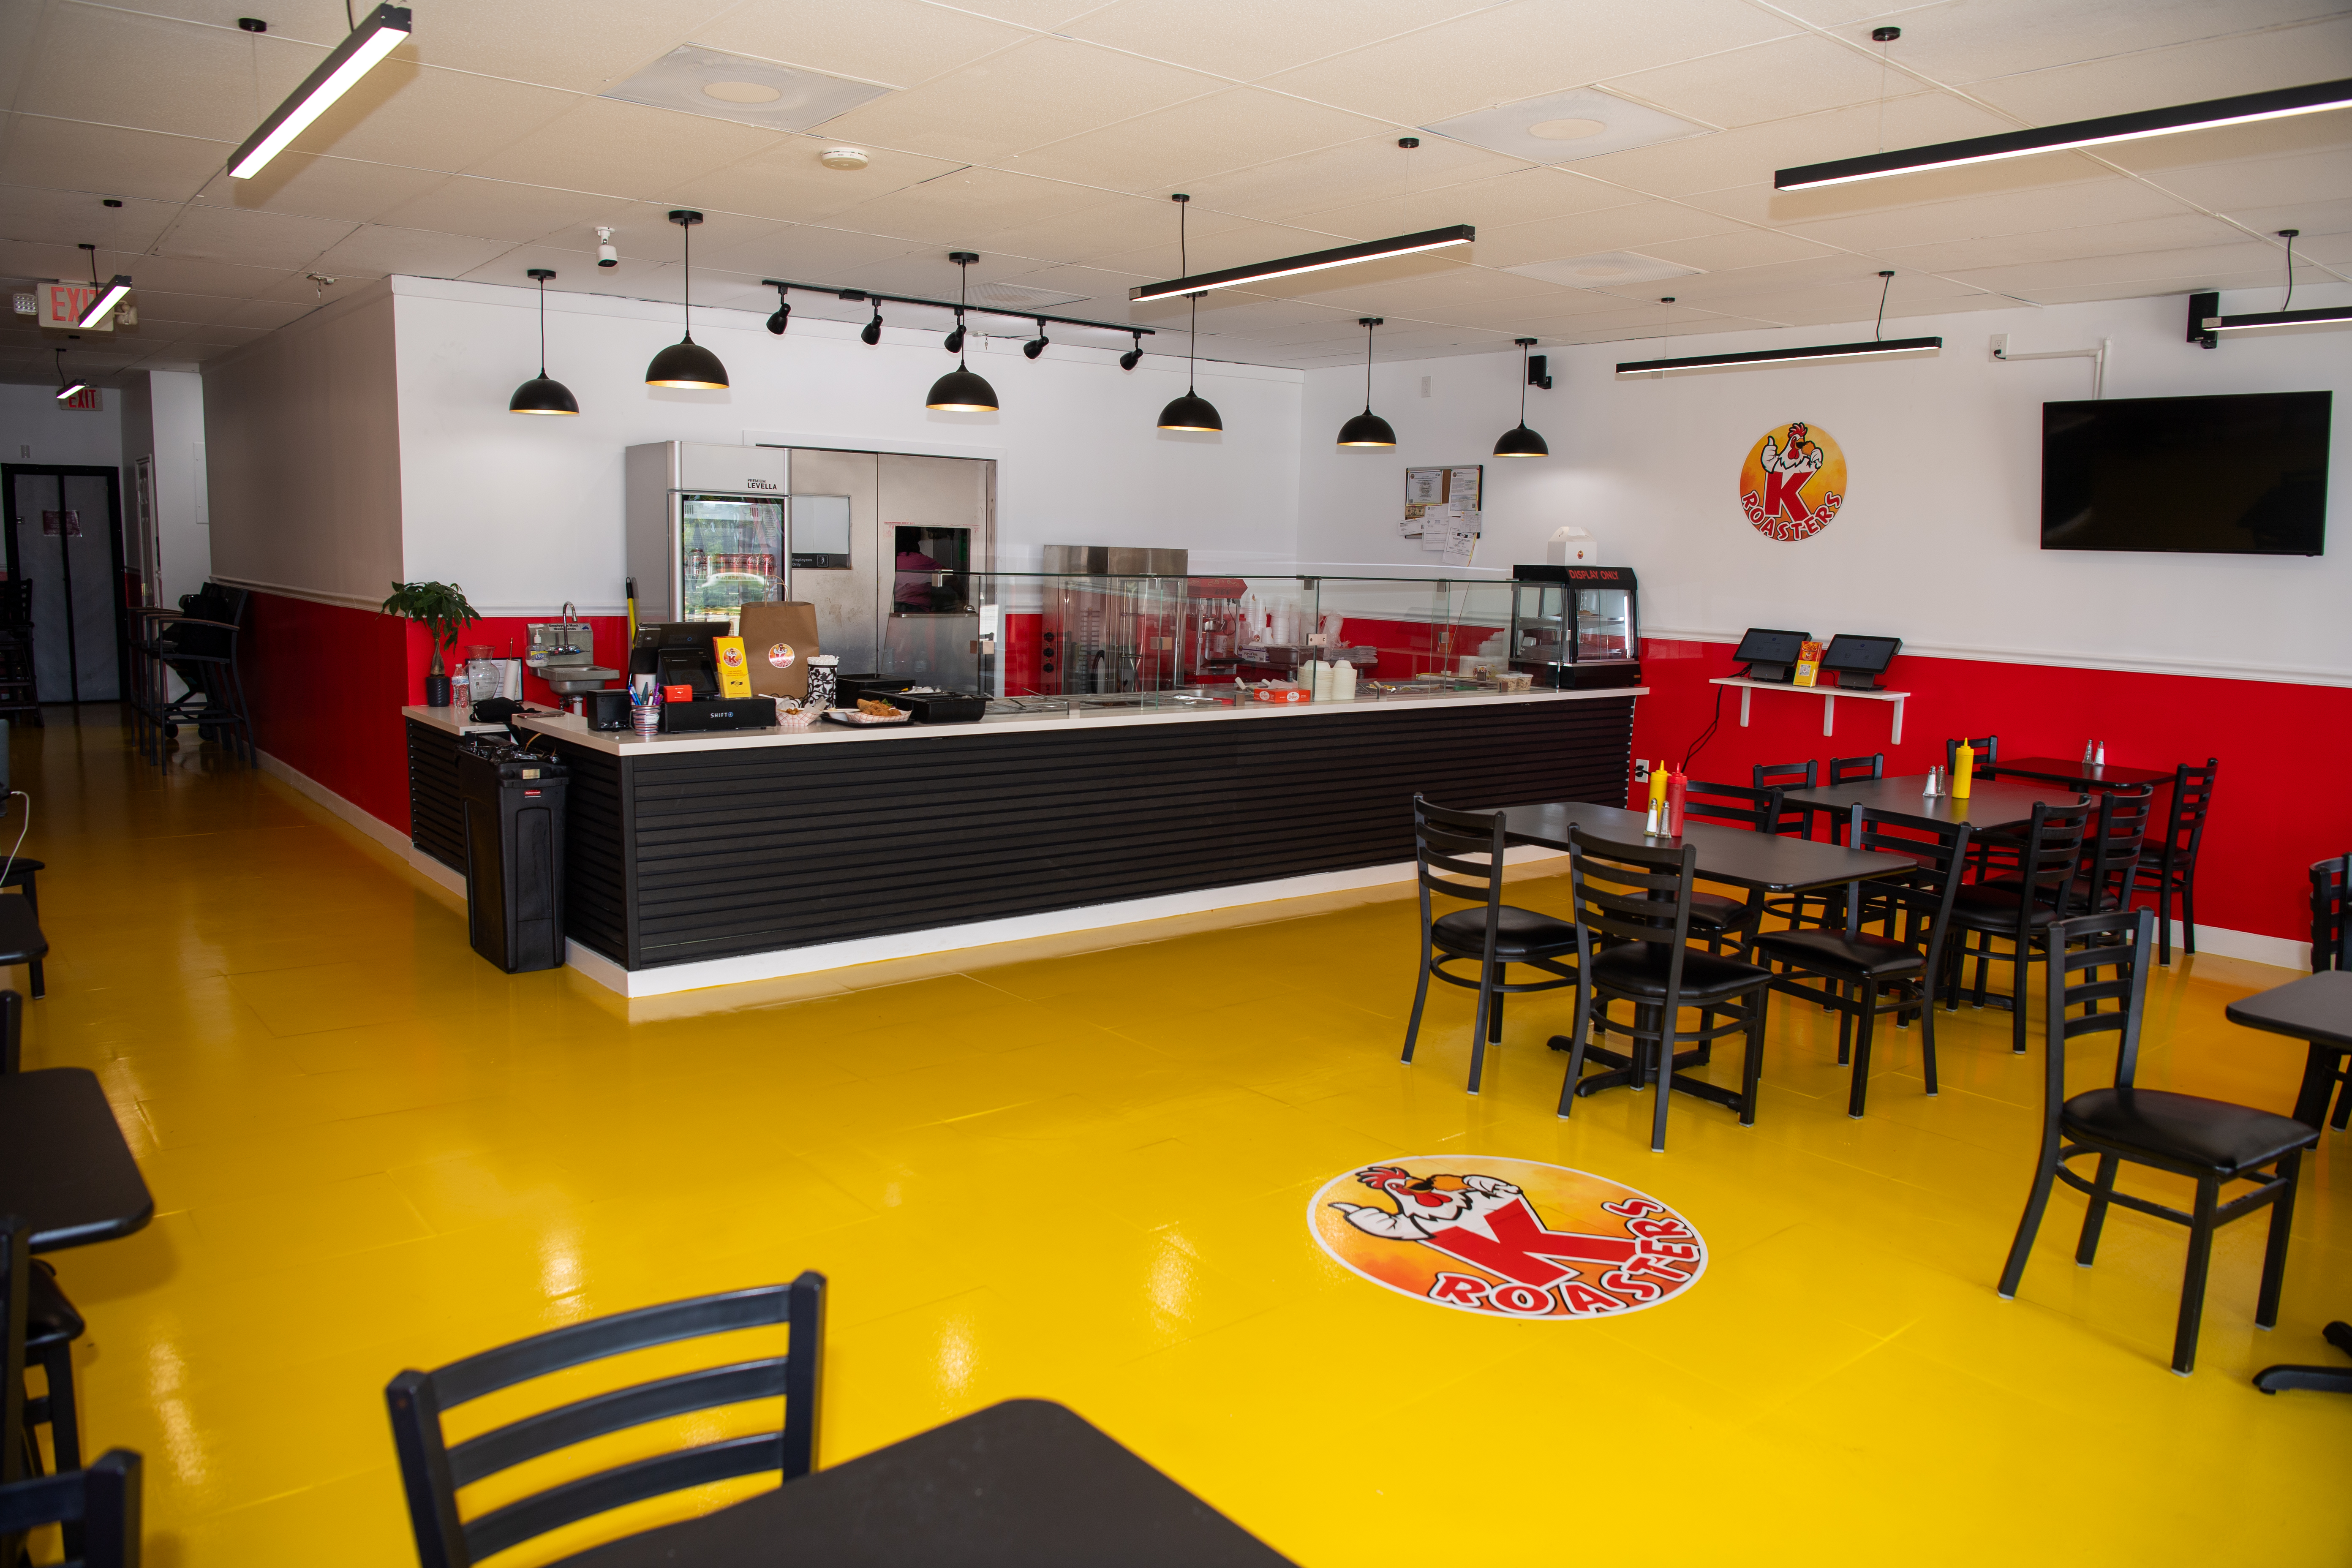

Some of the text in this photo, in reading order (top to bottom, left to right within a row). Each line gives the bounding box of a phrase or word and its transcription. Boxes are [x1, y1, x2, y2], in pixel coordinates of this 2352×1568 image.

[68, 389, 96, 408] EXIT
[1741, 489, 1843, 541] ROASTERS
[1763, 470, 1815, 524] K
[1569, 570, 1619, 580] DISPLAY ONLY
[1424, 1196, 1639, 1289] K
[1429, 1198, 1701, 1315] ROASTERS
